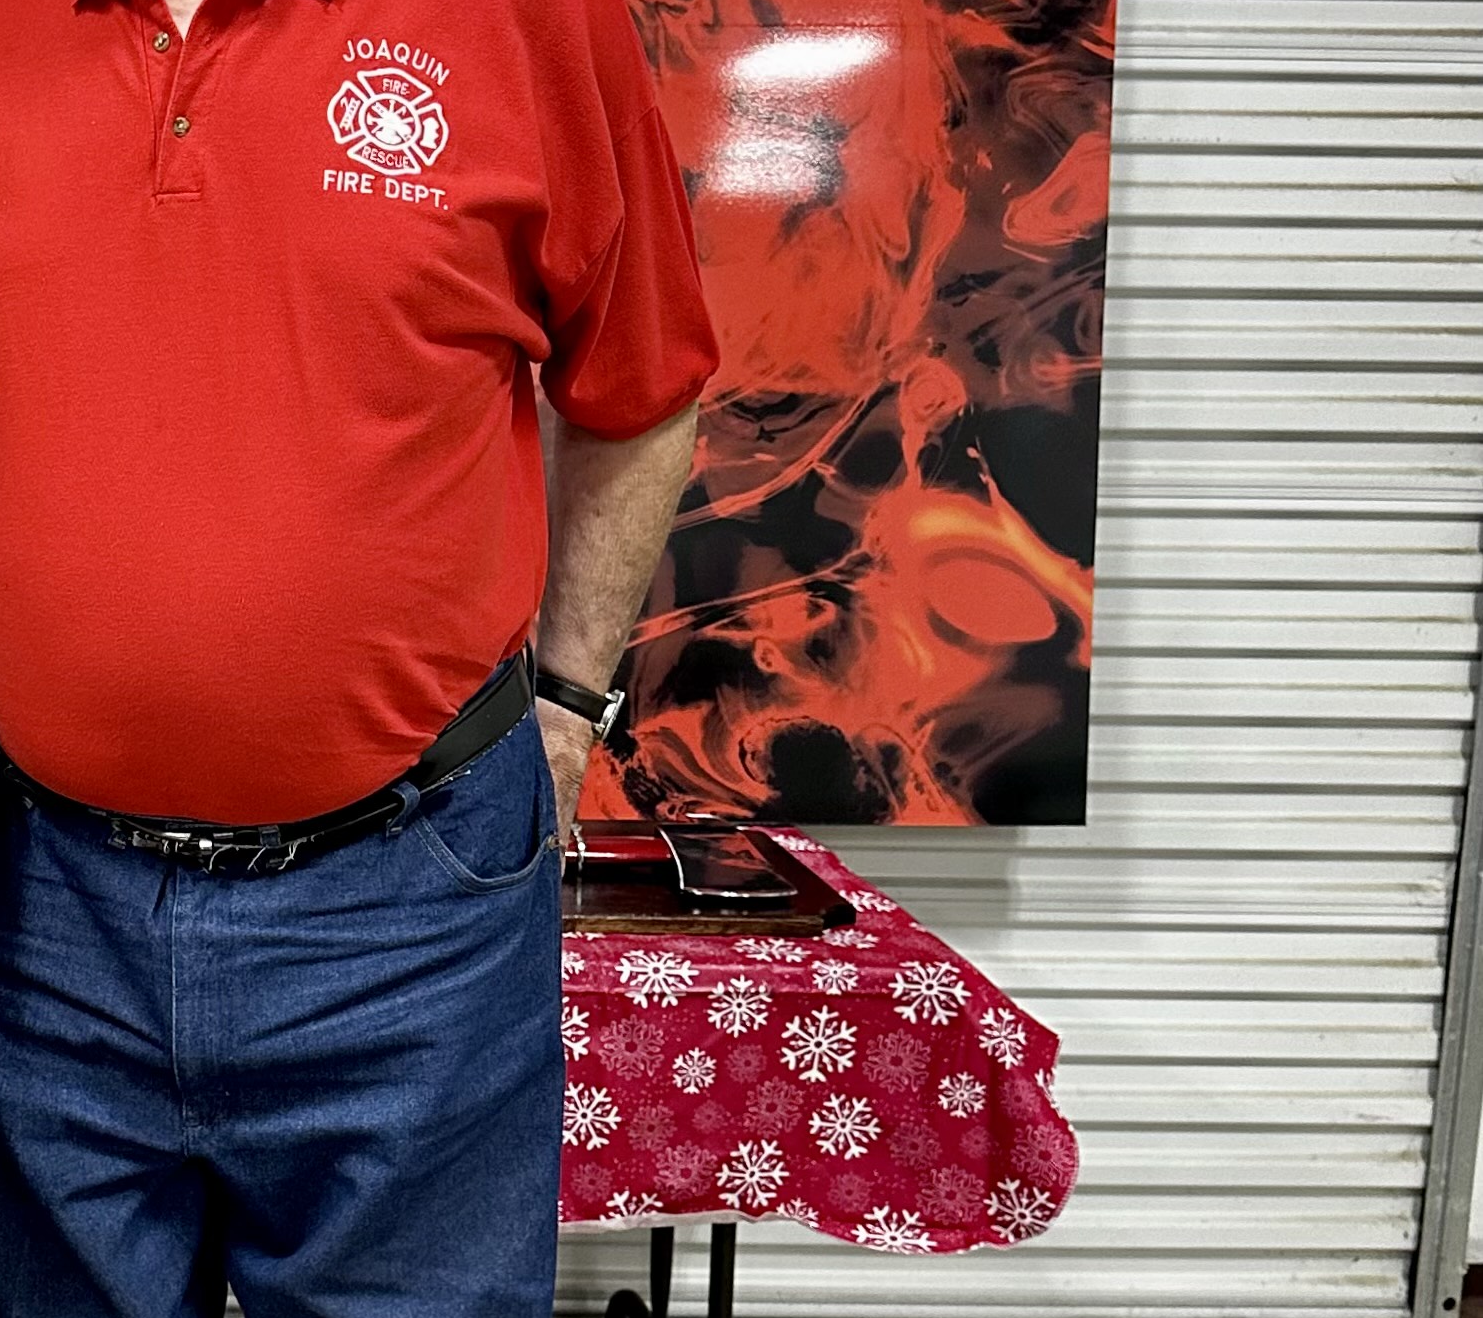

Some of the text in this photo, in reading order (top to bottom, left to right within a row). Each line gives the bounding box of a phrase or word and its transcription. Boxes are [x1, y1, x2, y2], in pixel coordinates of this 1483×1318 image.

[342, 38, 451, 86] JOAQUIN
[382, 78, 410, 95] FIRE
[361, 146, 411, 169] RESCUE
[322, 169, 450, 210] FIRE DEPT.
